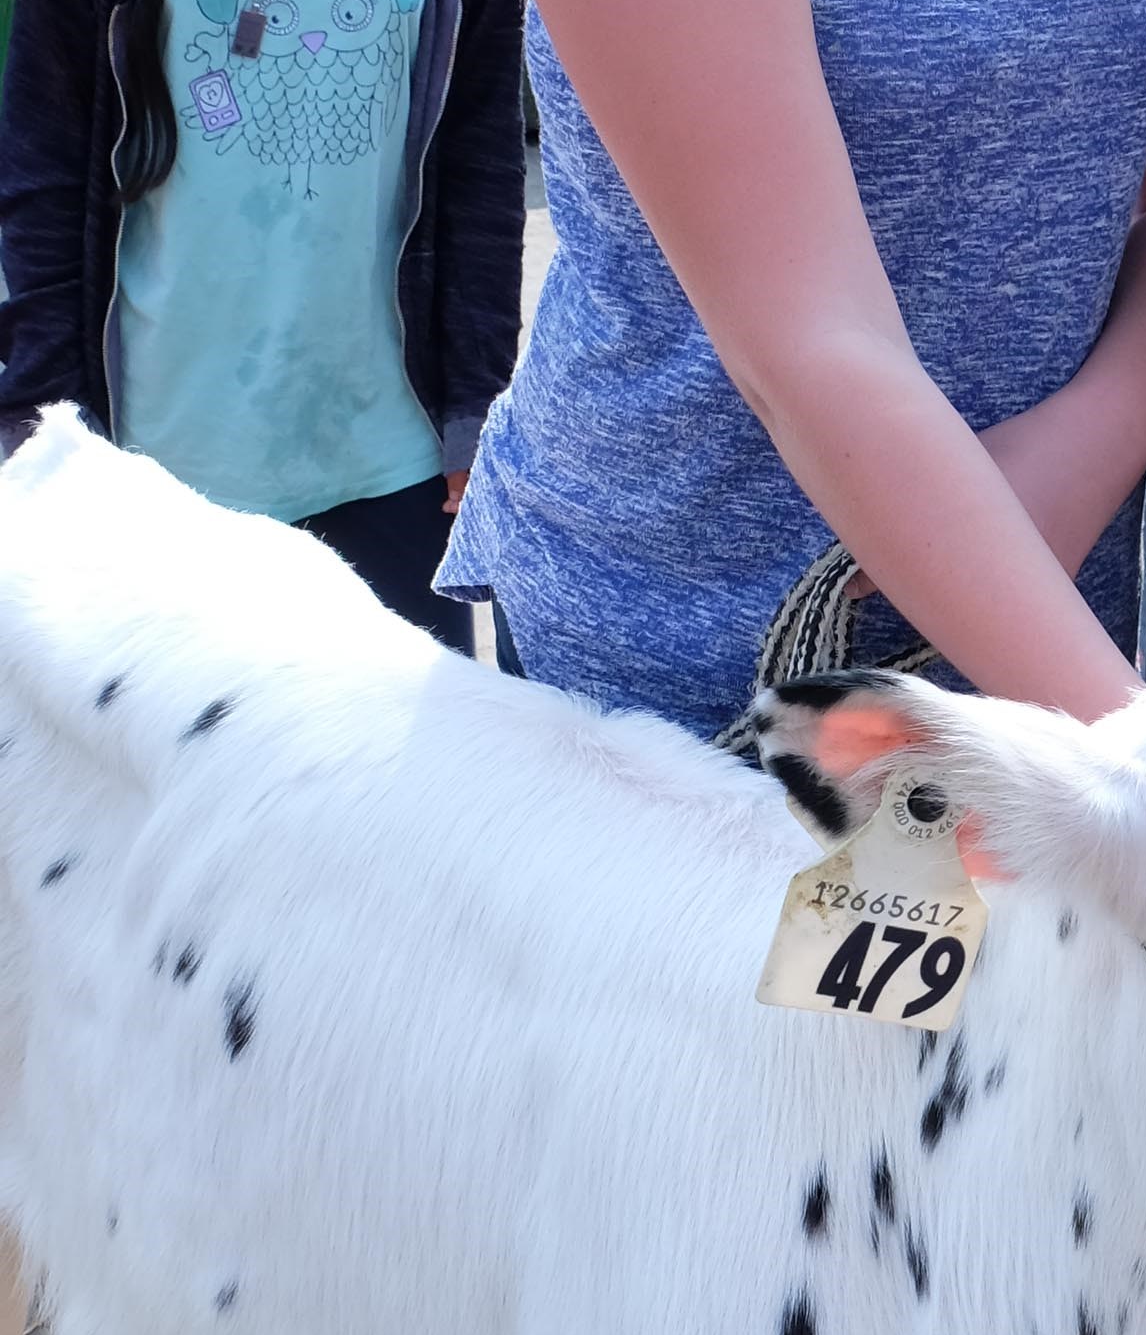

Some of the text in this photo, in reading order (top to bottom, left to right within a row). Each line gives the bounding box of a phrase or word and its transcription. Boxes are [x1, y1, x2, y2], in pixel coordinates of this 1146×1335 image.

[908, 825, 933, 839] 012
[812, 881, 964, 927] 12665617
[816, 921, 966, 1019] 479
